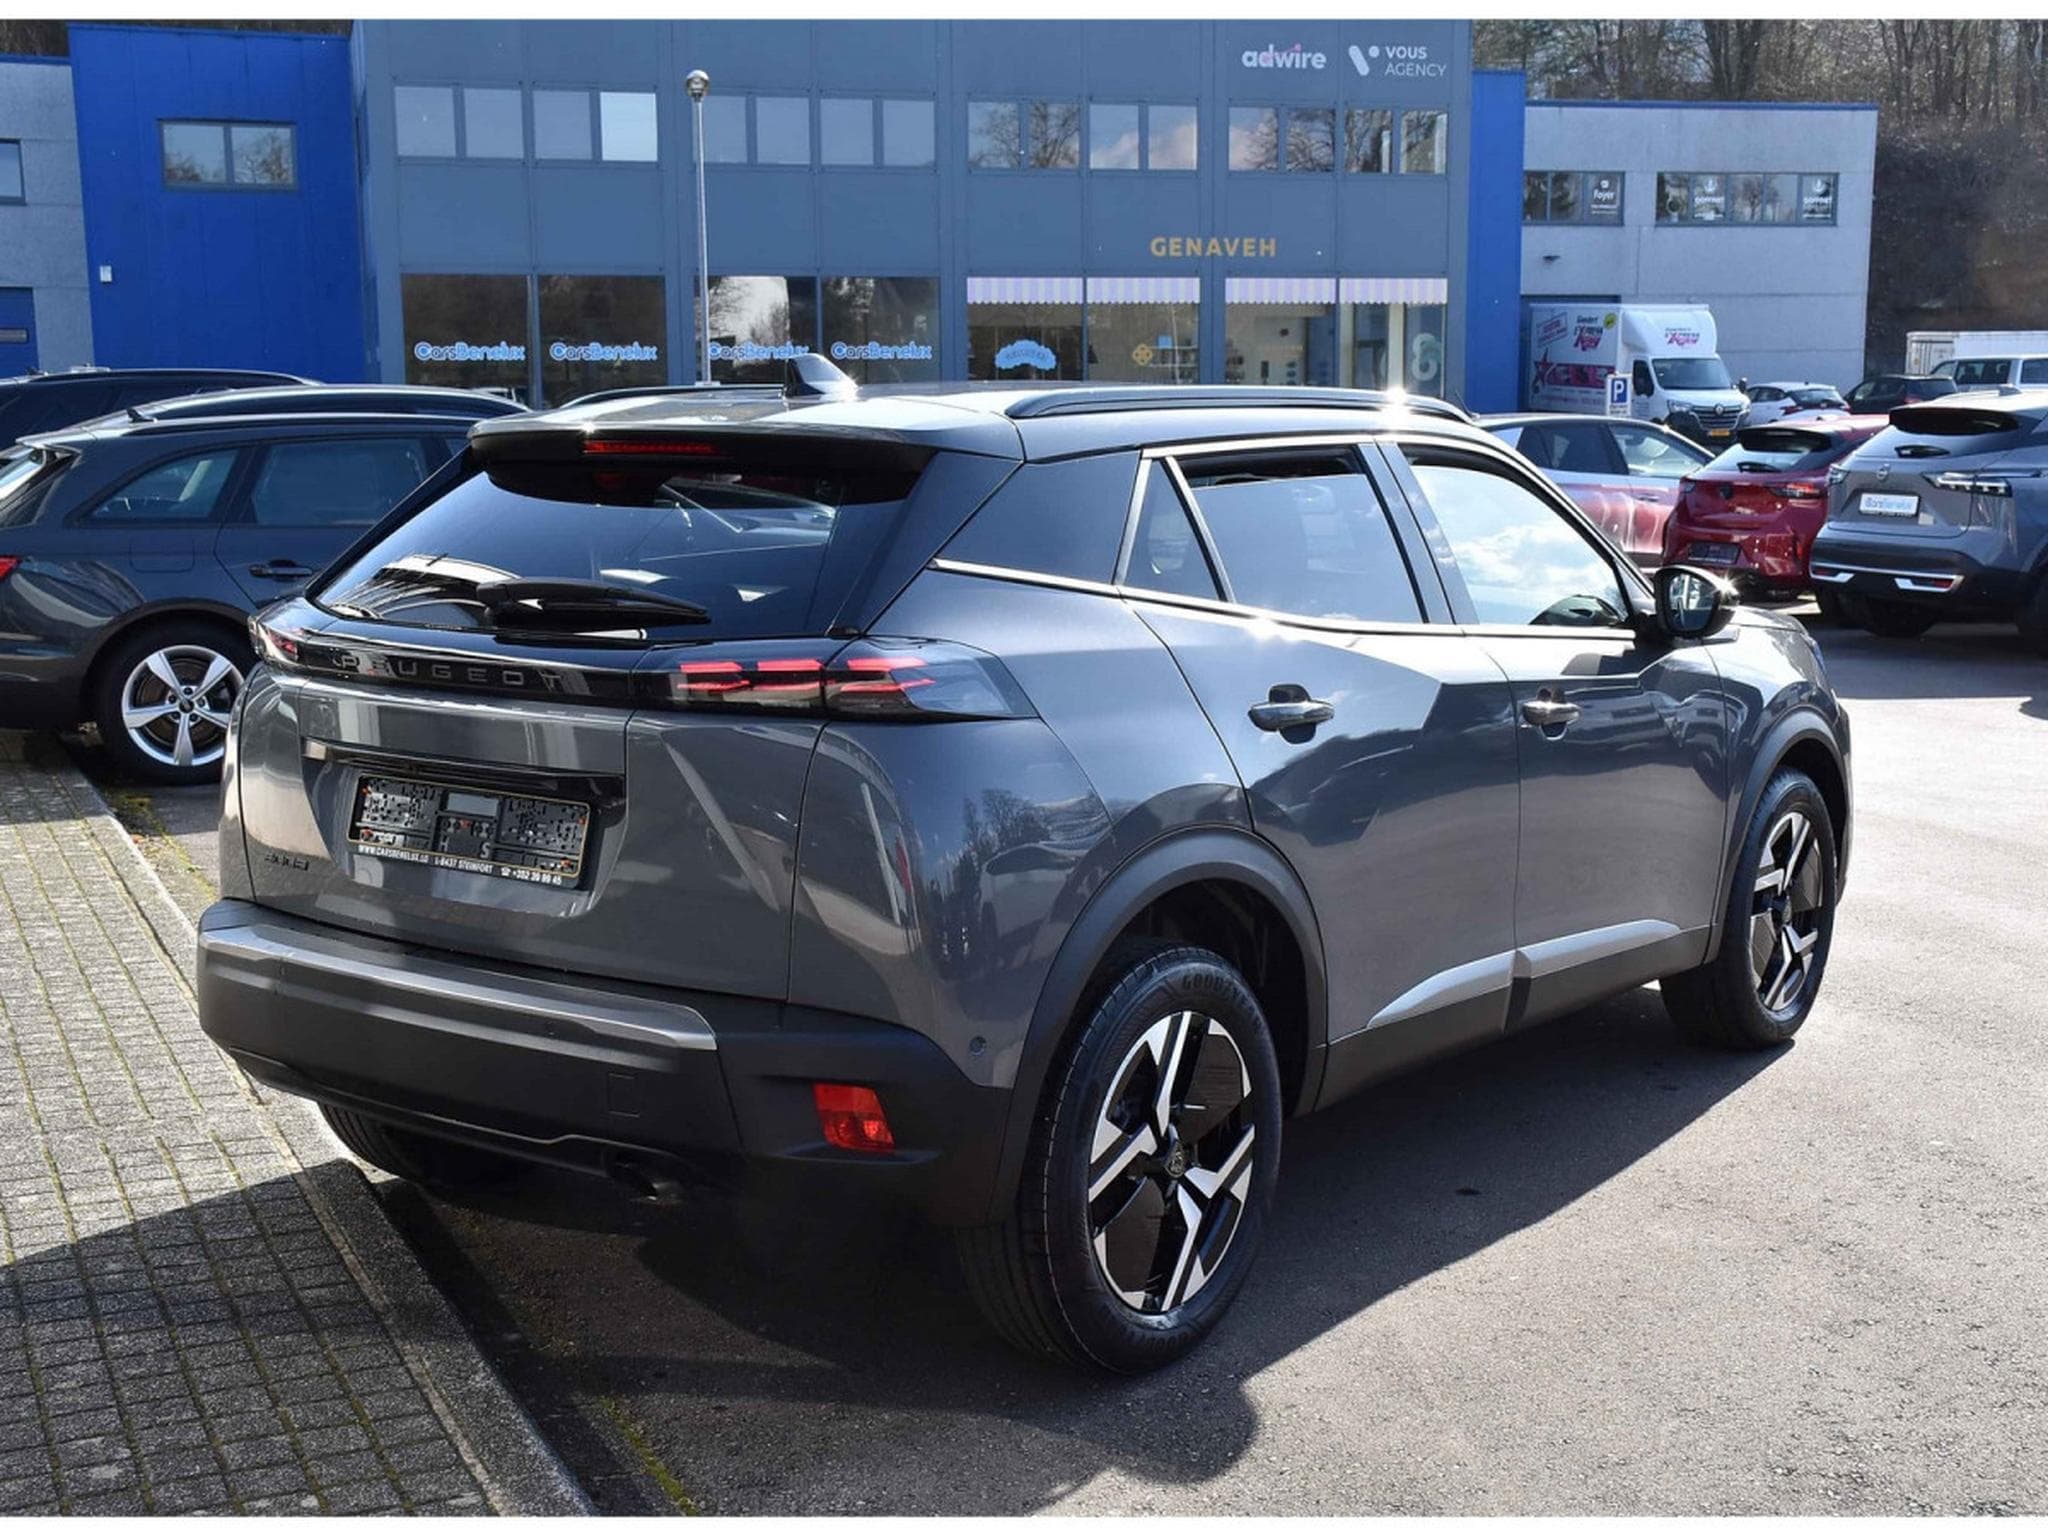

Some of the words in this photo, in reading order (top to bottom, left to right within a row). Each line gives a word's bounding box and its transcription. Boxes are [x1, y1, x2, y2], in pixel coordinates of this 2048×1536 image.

[1241, 43, 1327, 69] adwire
[1384, 45, 1428, 60] VOUS
[1384, 62, 1447, 77] AGENCY
[1149, 236, 1277, 257] GENAVEH
[414, 340, 526, 361] CarsBenelux
[549, 340, 658, 361] CarsBenelux
[708, 341, 809, 360] CarsBenelux
[830, 341, 933, 361] CarsBenelux
[1613, 380, 1625, 402] P
[341, 654, 562, 689] PEUGEOT
